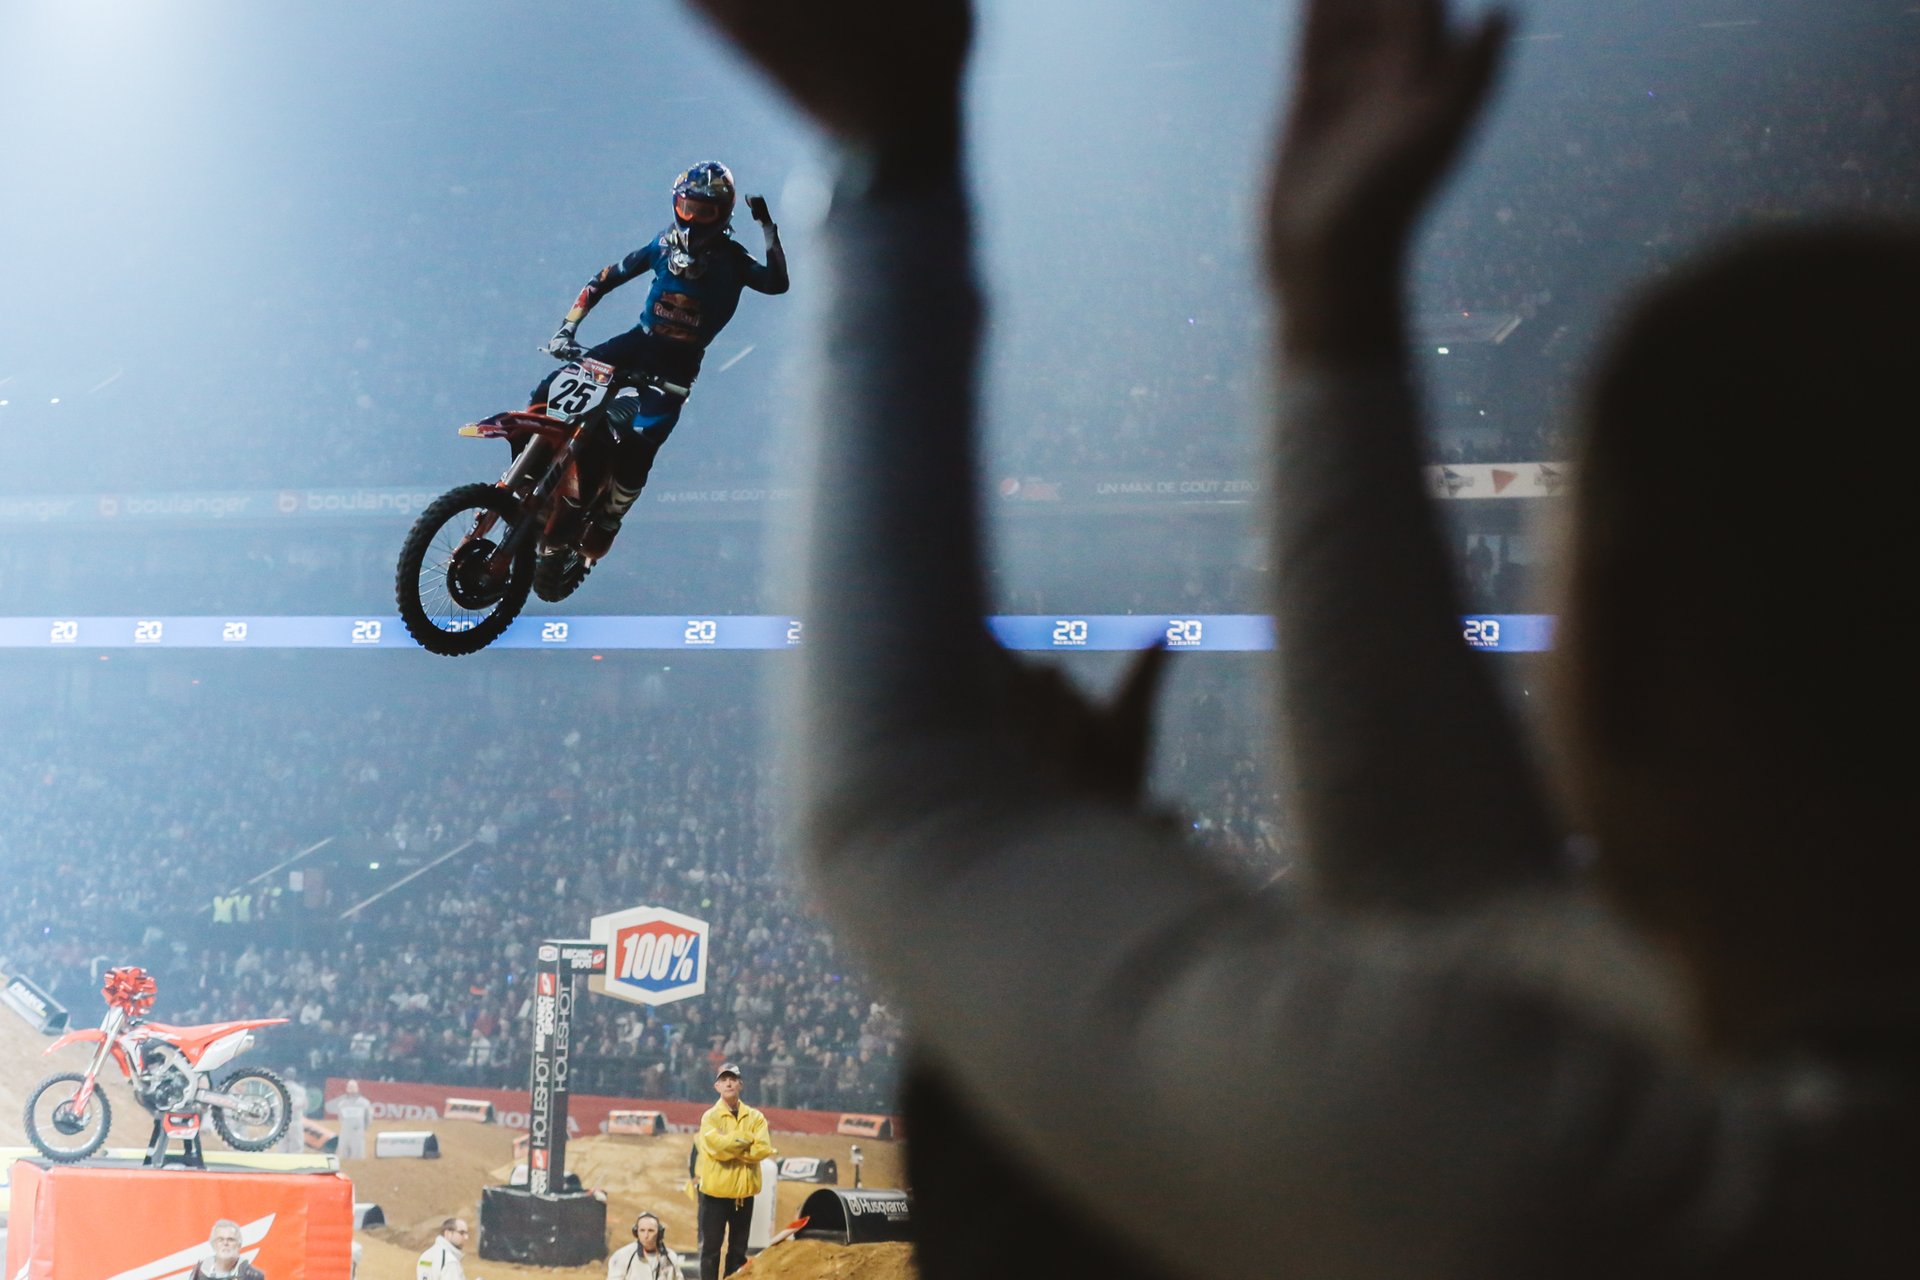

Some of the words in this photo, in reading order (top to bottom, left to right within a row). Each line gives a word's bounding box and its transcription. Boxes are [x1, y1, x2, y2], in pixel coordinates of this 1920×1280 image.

[548, 378, 598, 414] 25
[711, 490, 728, 502] DE
[1156, 481, 1176, 493] DE
[127, 494, 251, 519] boulanger
[50, 620, 78, 640] 20
[134, 620, 163, 640] 20
[222, 621, 248, 639] 20
[351, 620, 382, 640] 20
[541, 621, 569, 640] 20
[684, 620, 717, 640] 20
[786, 620, 803, 640] 2
[1052, 620, 1088, 641] 20
[1166, 619, 1203, 641] 20
[1463, 619, 1500, 641] 20
[620, 932, 697, 982] 100%
[553, 982, 571, 1092] HOLESHOT
[532, 1053, 550, 1147] HOLESHOT
[370, 1102, 439, 1121] ONDA
[859, 1198, 909, 1215] Husqvarna
